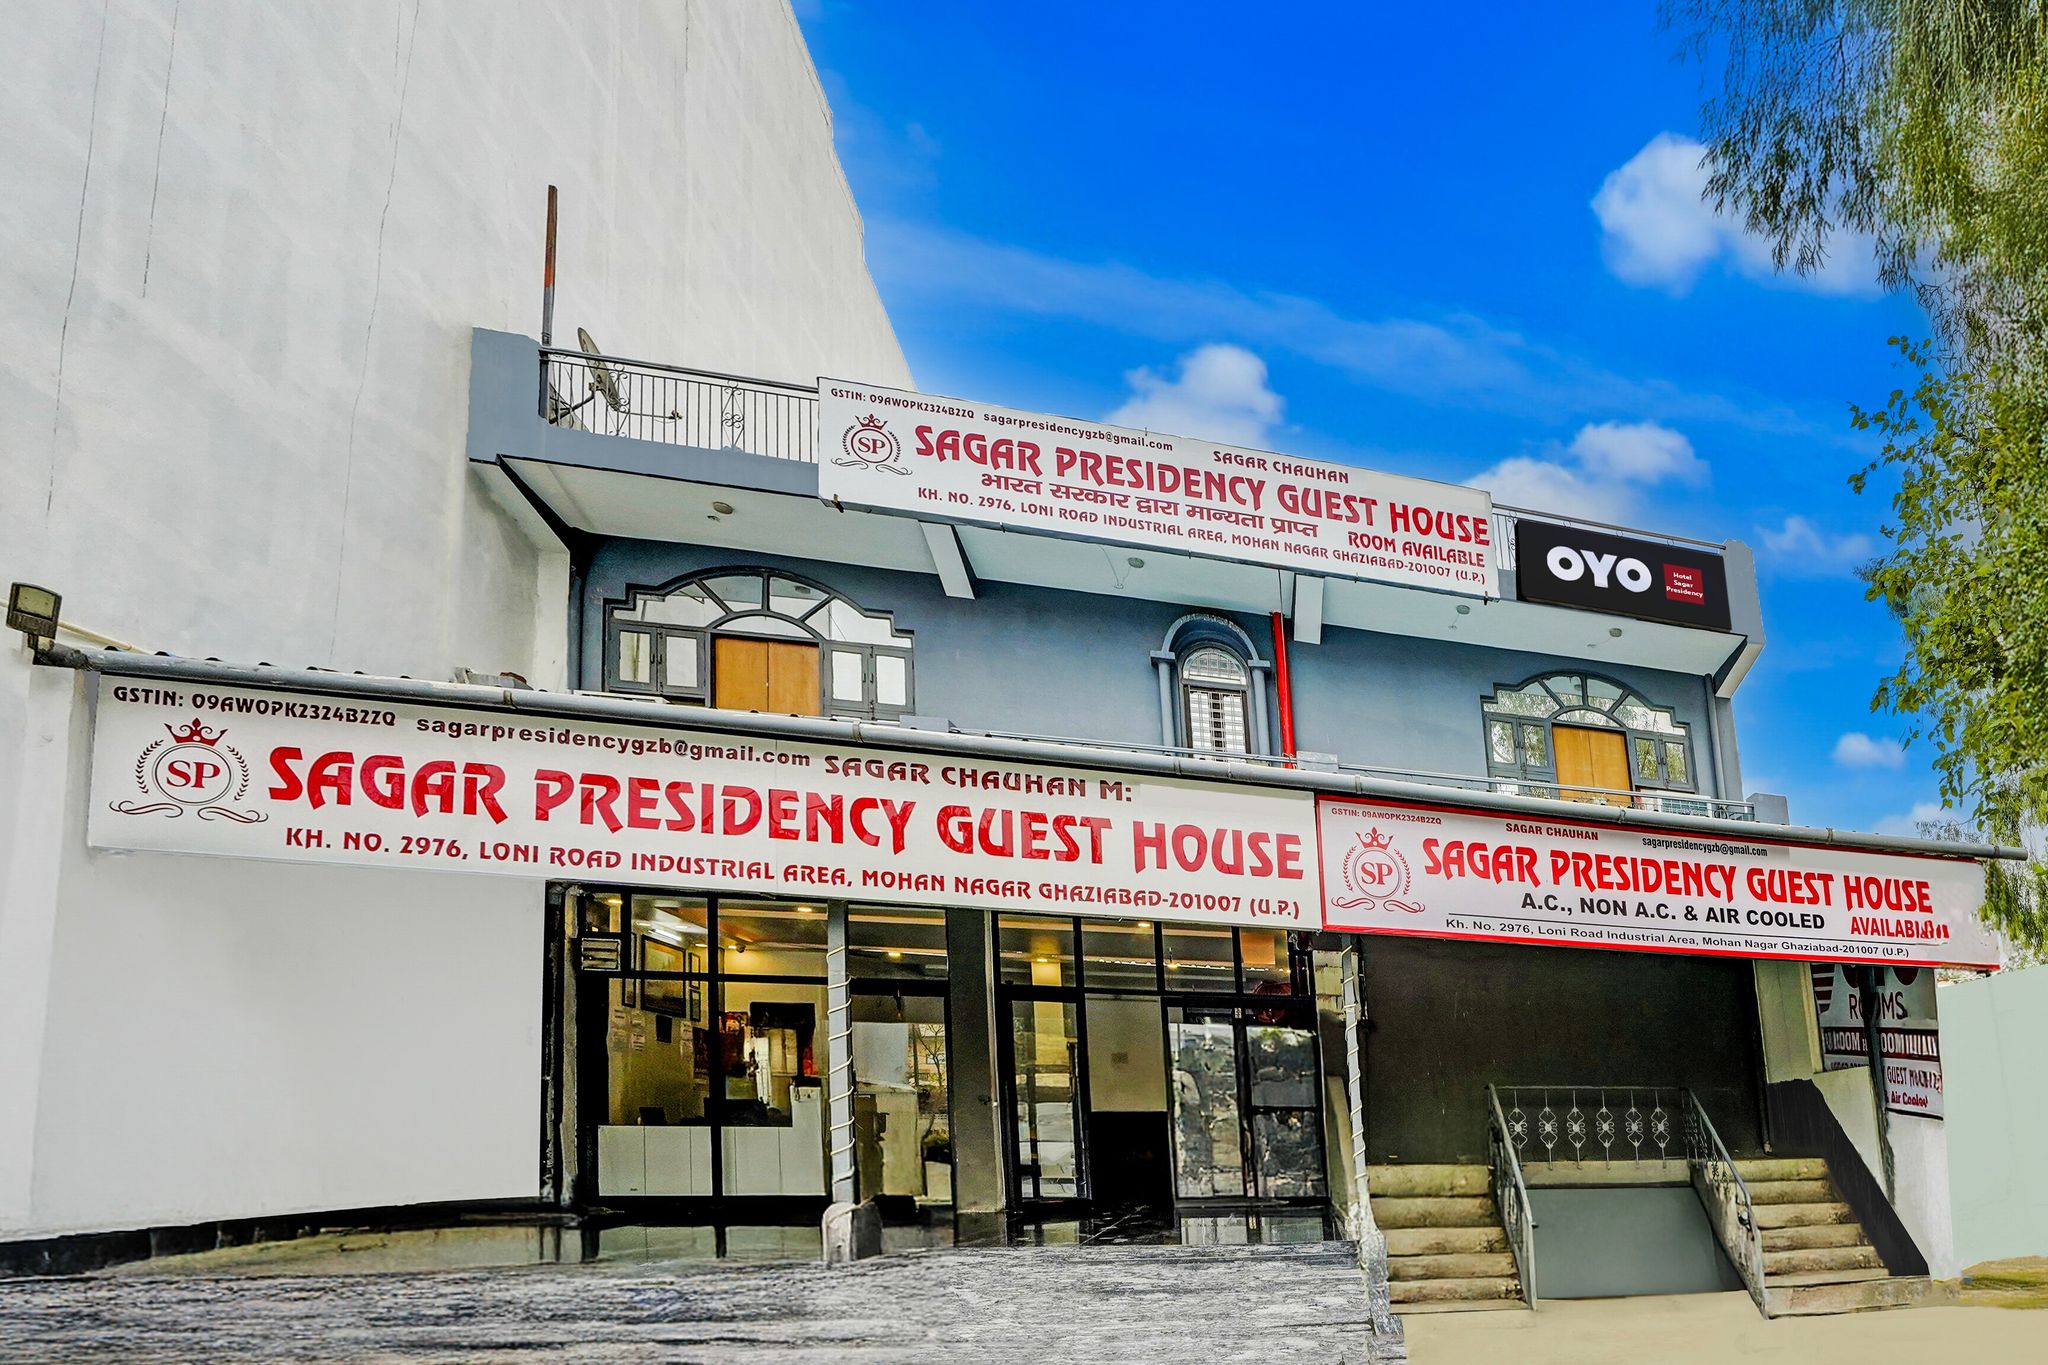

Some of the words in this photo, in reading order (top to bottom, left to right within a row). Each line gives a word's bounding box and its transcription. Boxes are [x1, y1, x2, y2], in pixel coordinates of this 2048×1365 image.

[831, 388, 866, 401] GSTIN:
[857, 437, 885, 454] SP
[983, 413, 1173, 450] sagarpresidencygzb@gmail.com
[1213, 450, 1267, 471] SAGAR
[1273, 461, 1349, 484] CHAUHAN
[914, 425, 1043, 477] SAGAR
[1056, 447, 1266, 511] PRESIDENCY
[1277, 484, 1377, 526] GUEST
[1389, 502, 1490, 546] HOUSE
[981, 473, 1042, 495] भारत
[1050, 483, 1130, 508] सरकार
[1135, 496, 1179, 516] द्वारा
[1185, 504, 1264, 529] मान्यता
[1270, 517, 1318, 537] प्राप्त
[918, 487, 942, 501] KH.
[948, 492, 973, 505] NO.
[979, 496, 1015, 513] 2976,
[1021, 502, 1053, 517] LONI
[1059, 509, 1098, 523] ROAD
[1104, 515, 1184, 536] INDUSTRIAL
[1188, 528, 1227, 544] AREA,
[1232, 534, 1279, 551] MOHAN
[1284, 543, 1328, 559] NAGAR
[1333, 550, 1451, 577] GHAZIABAD-201007
[1456, 570, 1485, 585] (U.P.)
[1348, 531, 1396, 553] ROOM
[1402, 541, 1485, 568] AVAILABLE
[1546, 545, 1652, 593] OYO
[1673, 572, 1692, 581] Hotel
[1673, 580, 1693, 589] Sagar
[1666, 586, 1703, 599] Presidency
[113, 686, 183, 707] GSTIN:
[416, 716, 810, 766] sagarpresidencygzb@gmail.com
[166, 760, 221, 789] SP
[824, 755, 931, 785] SAGAR
[941, 766, 1086, 797] CHAUHAN
[1099, 779, 1132, 802] M:
[268, 746, 508, 825] SAGAR
[534, 768, 916, 856] PRESIDENCY
[936, 804, 1112, 865] GUEST
[1132, 820, 1303, 880] HOUSE
[1331, 807, 1360, 817] GSTIN:
[1505, 822, 1543, 835] SAGAR
[1546, 827, 1599, 841] CHAUHAN
[1642, 837, 1768, 856] sagarpresidencygzb@gmail.com
[286, 828, 331, 850] KH.
[344, 832, 389, 853] NO.
[400, 836, 468, 860] 2976,
[479, 841, 539, 862] LONI
[550, 847, 621, 869] ROAD
[631, 853, 775, 881] INDUSTRIAL
[784, 864, 852, 887] AREA,
[862, 869, 945, 892] MOHAN
[955, 876, 1031, 899] NAGAR
[1038, 883, 1241, 912] GHAZIABAD-201007
[1250, 898, 1300, 920] (U.P.)
[1361, 861, 1393, 886] SP
[1422, 837, 1541, 888] SAGAR
[1549, 850, 1736, 904] PRESIDENCY
[1747, 867, 1834, 907] GUEST
[1843, 874, 1933, 914] HOUSE
[1521, 893, 1572, 916] A.C.,
[1580, 897, 1626, 916] NON
[1634, 902, 1676, 920] A.C.
[1684, 906, 1698, 921] &
[1706, 907, 1739, 924] AIR
[1746, 909, 1825, 929] COOLED
[1446, 919, 1468, 929] Kh.
[1473, 920, 1495, 932] No.
[1499, 922, 1534, 935] 2976,
[1538, 925, 1566, 936] Loni
[1571, 928, 1603, 939] Road
[1607, 930, 1665, 943] Industrial
[1668, 935, 1699, 946] Area,
[1703, 936, 1743, 948] Mohan
[1745, 940, 1779, 952] Nagar
[1781, 942, 1879, 955] Ghaziabad-201007
[1882, 947, 1909, 958] (U.P.)
[1849, 991, 1908, 1020] RMS
